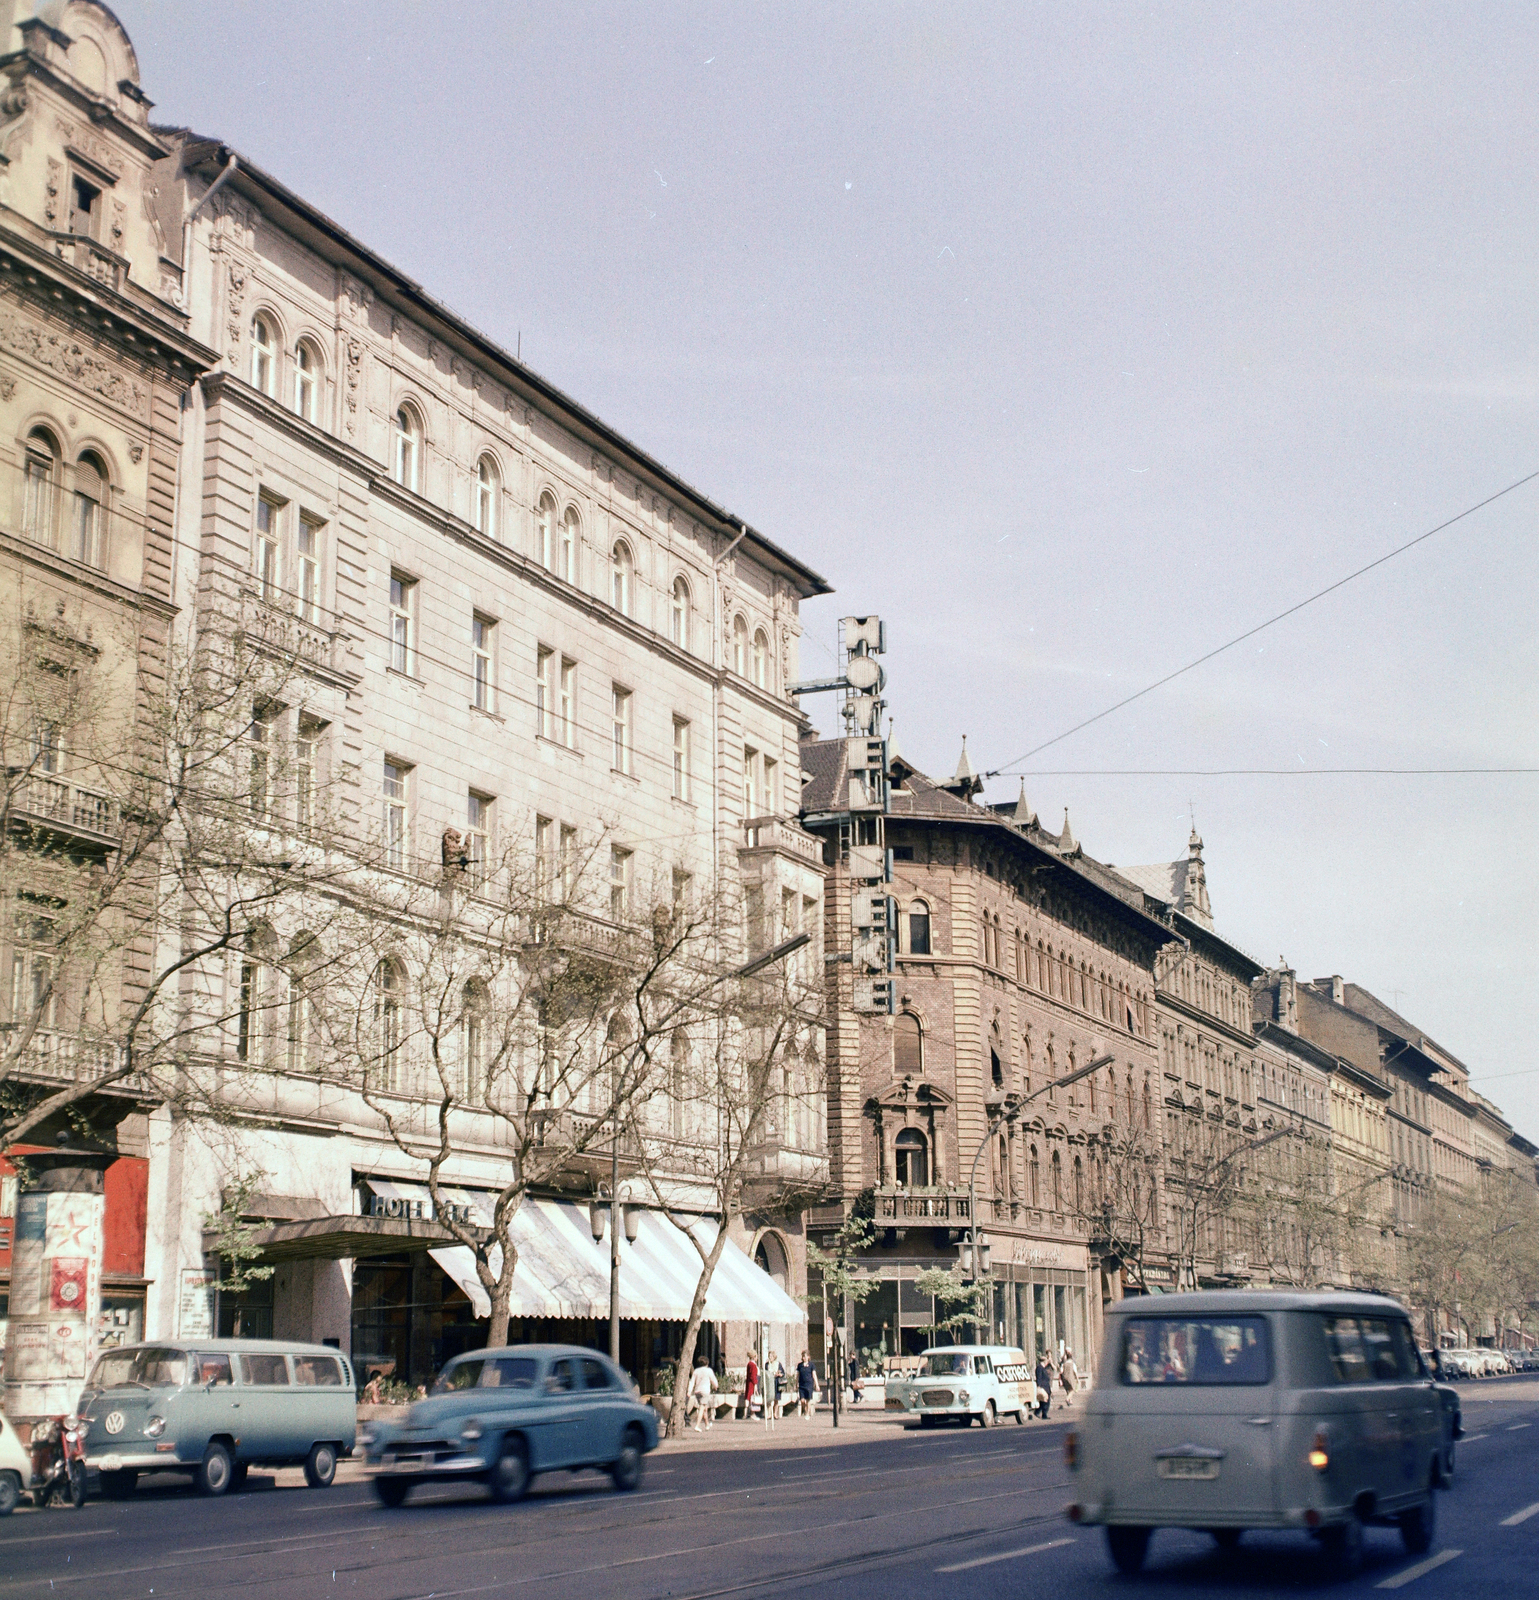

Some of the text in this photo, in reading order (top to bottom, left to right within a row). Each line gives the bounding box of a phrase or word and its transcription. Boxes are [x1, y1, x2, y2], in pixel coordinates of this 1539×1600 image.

[845, 615, 888, 811] HOTEL
[371, 1195, 432, 1220] HOTEL
[105, 1412, 124, 1434] VW
